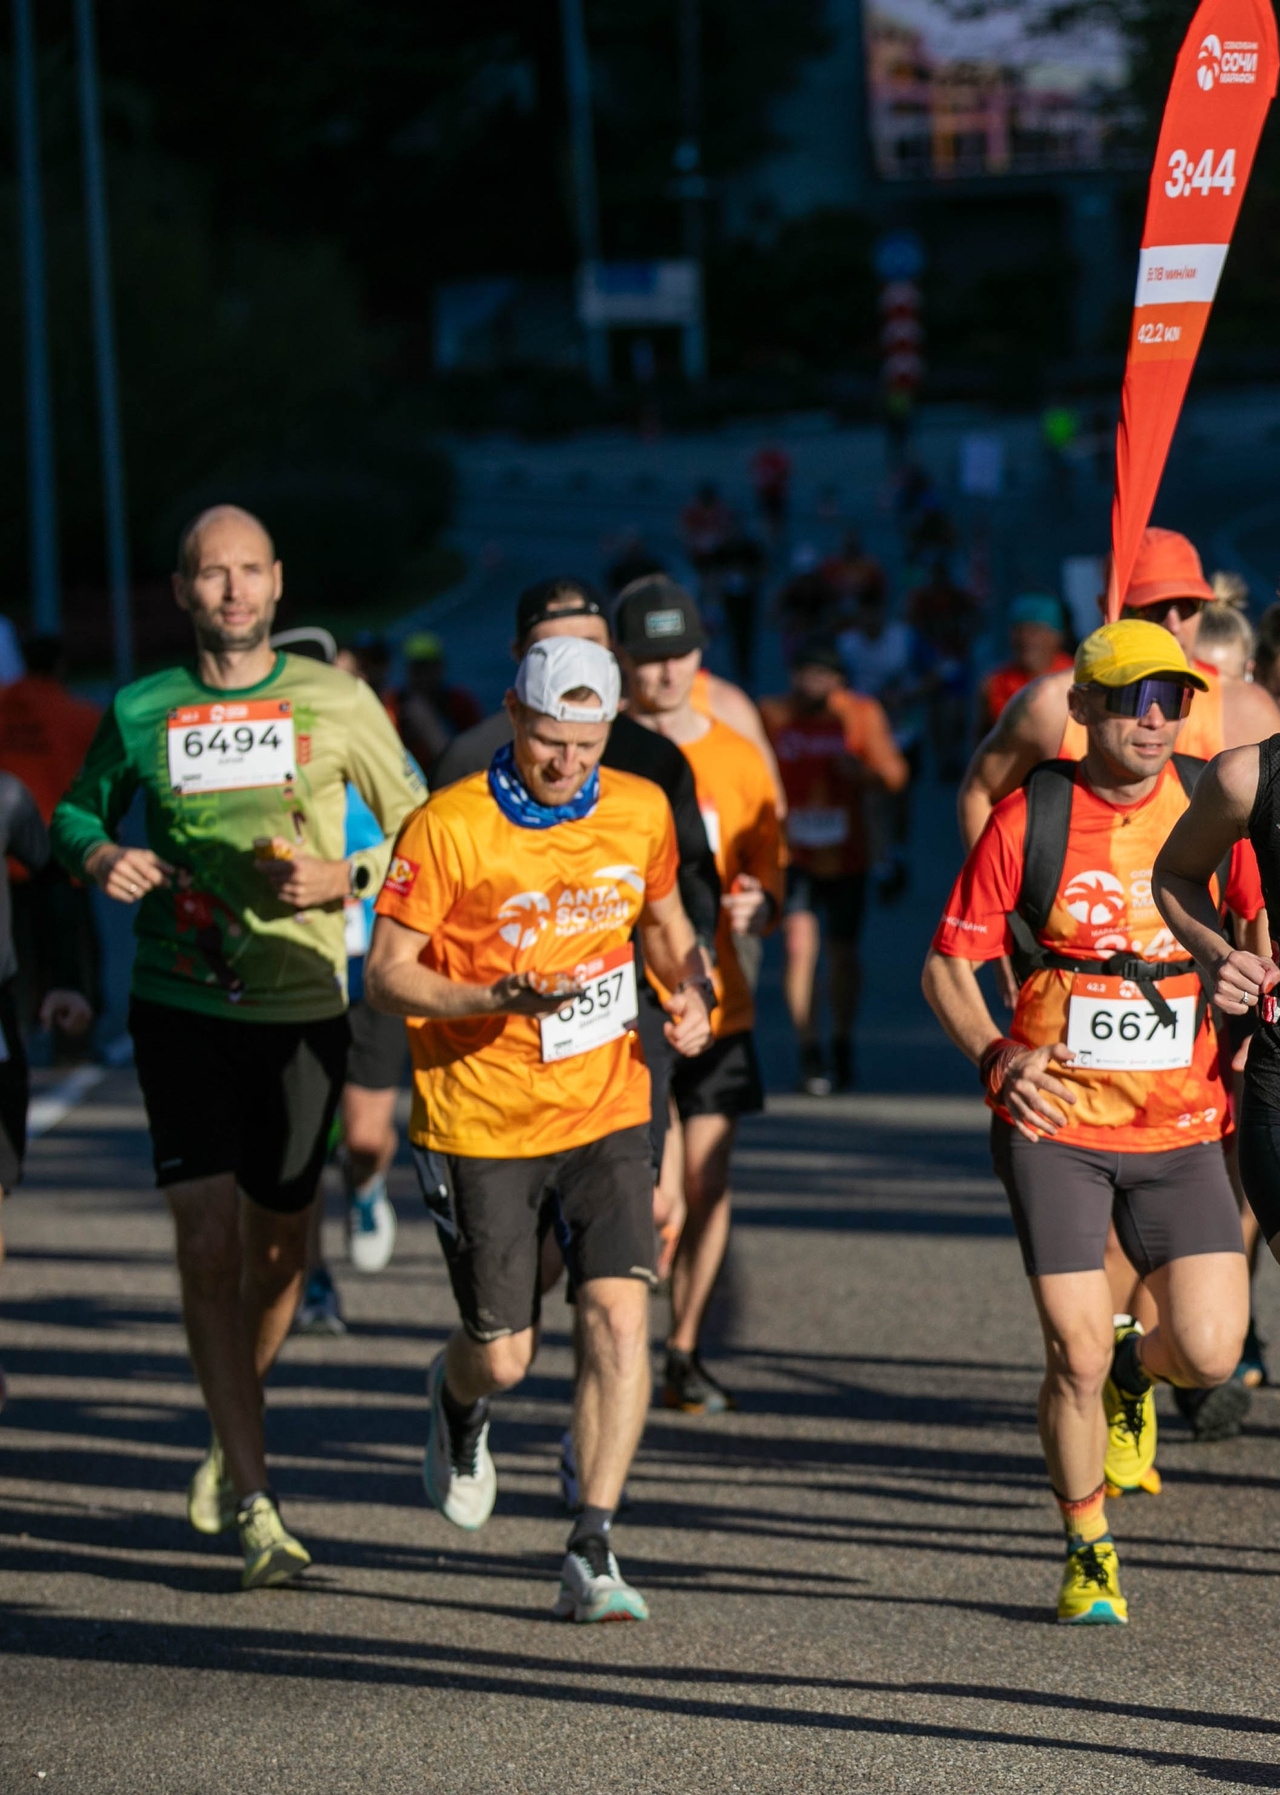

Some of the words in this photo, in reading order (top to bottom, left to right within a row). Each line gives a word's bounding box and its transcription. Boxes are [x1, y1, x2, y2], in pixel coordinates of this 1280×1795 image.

[1221, 52, 1258, 72] СОЧИ
[1165, 149, 1236, 198] 3:44
[1137, 322, 1164, 343] 42.2
[183, 724, 282, 758] 6494
[558, 886, 620, 906] ANTA
[556, 901, 629, 925] SOCHI
